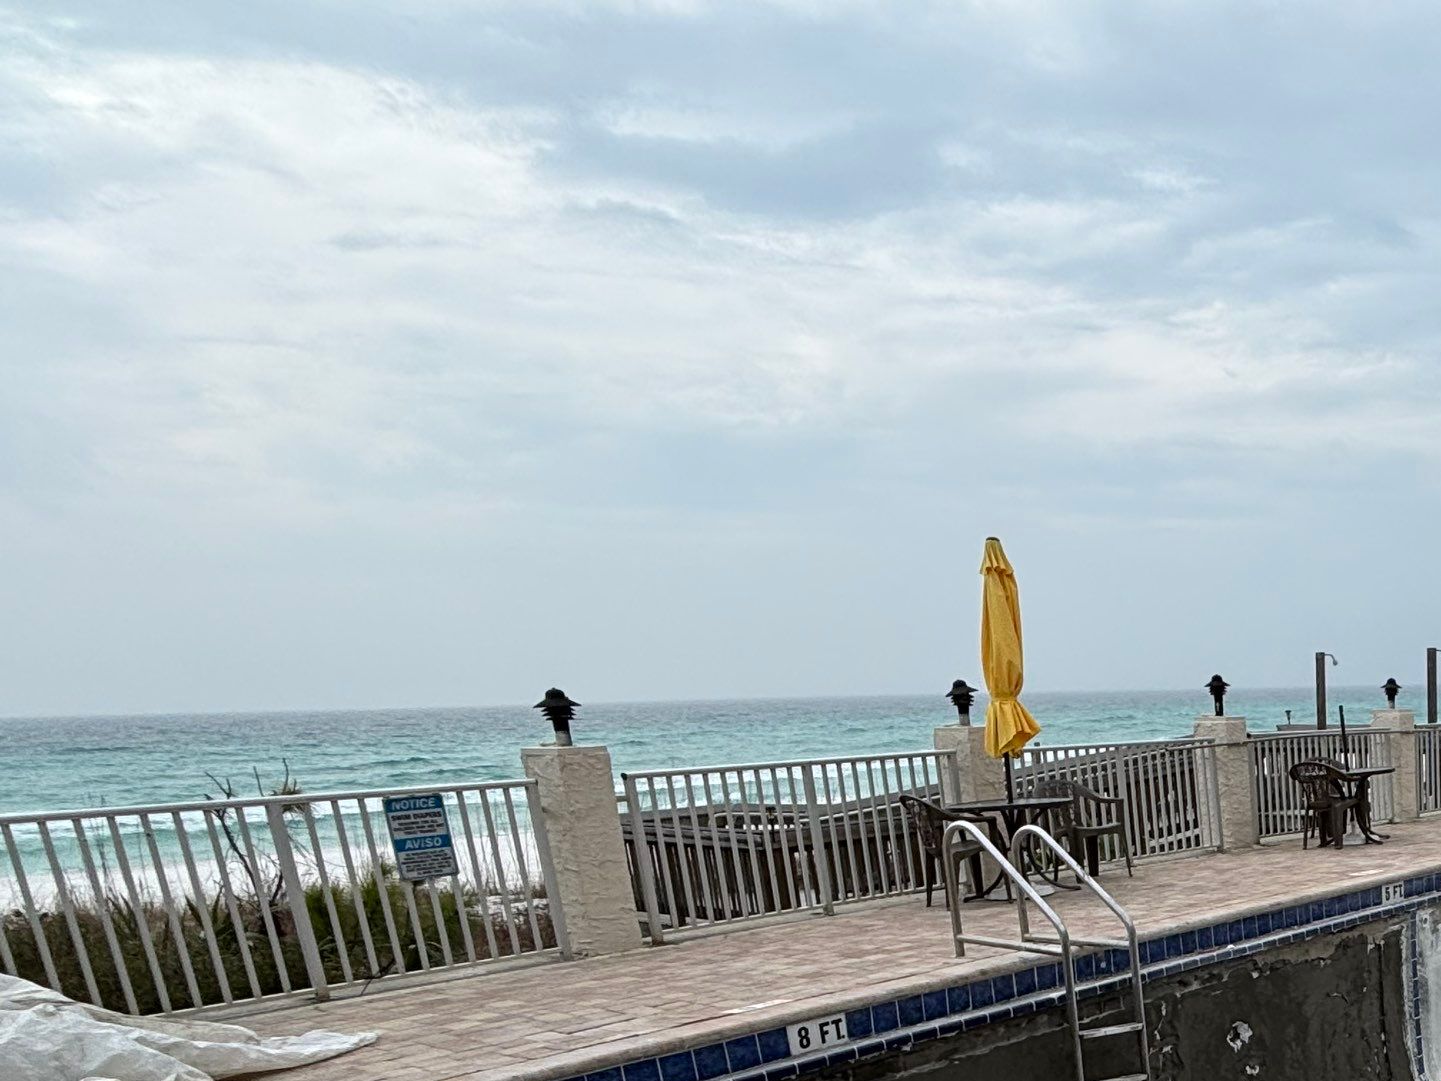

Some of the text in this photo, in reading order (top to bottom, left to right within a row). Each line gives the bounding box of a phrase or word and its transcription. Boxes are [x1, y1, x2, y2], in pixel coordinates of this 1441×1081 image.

[391, 797, 436, 811] NOTICE
[404, 836, 443, 850] AVISO
[1385, 886, 1391, 901] 5
[797, 1017, 846, 1049] 8 FT.
